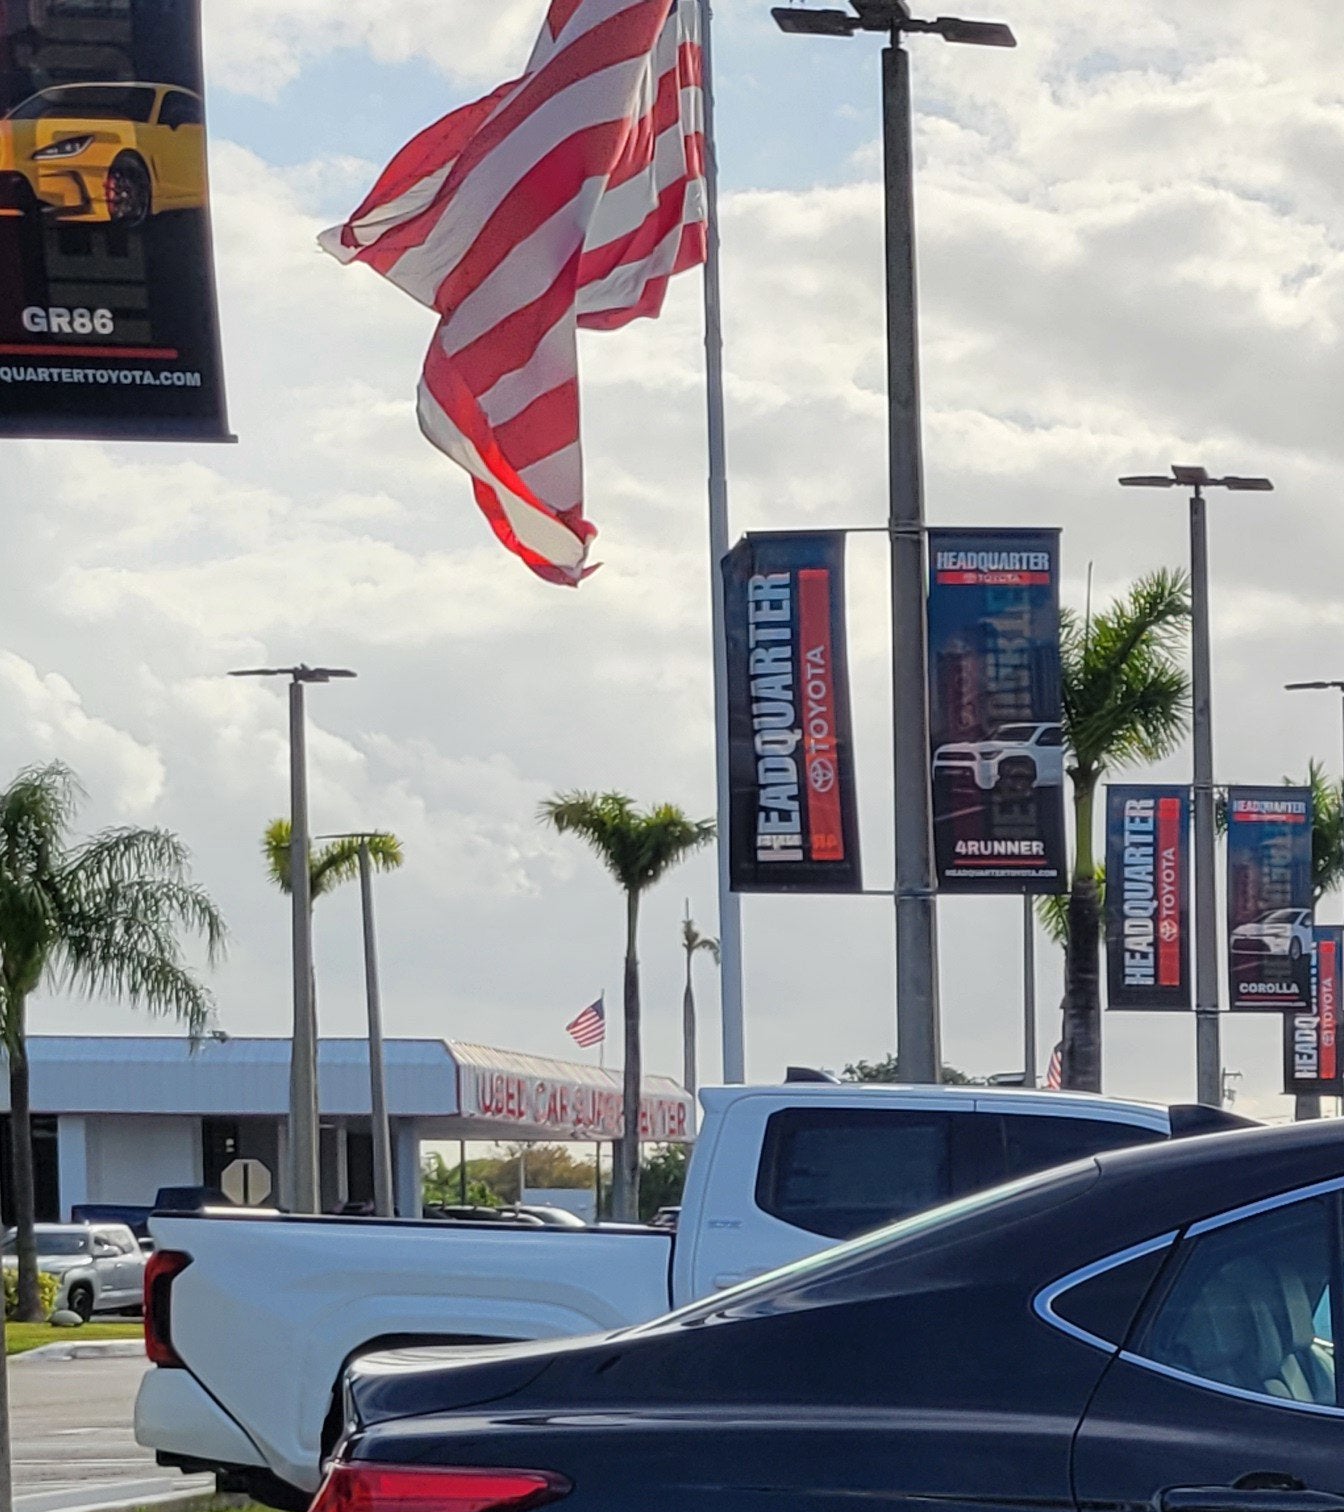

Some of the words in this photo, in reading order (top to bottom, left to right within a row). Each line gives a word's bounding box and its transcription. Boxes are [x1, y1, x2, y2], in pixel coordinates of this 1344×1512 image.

[22, 306, 115, 335] GR86
[0, 367, 202, 387] QUARTERTOYOTA.COM
[937, 551, 1049, 572] HEADQUARTER
[748, 571, 803, 862] HEADQUARTER
[807, 645, 830, 756] TOYOTA
[954, 840, 1045, 856] 4RUNNER
[1123, 799, 1157, 986] HEADQUARTER
[1159, 847, 1176, 916] TOYOTA
[1239, 982, 1299, 994] COROLLA
[1322, 977, 1334, 1029] TOYOTA
[638, 1099, 687, 1136] ENTER
